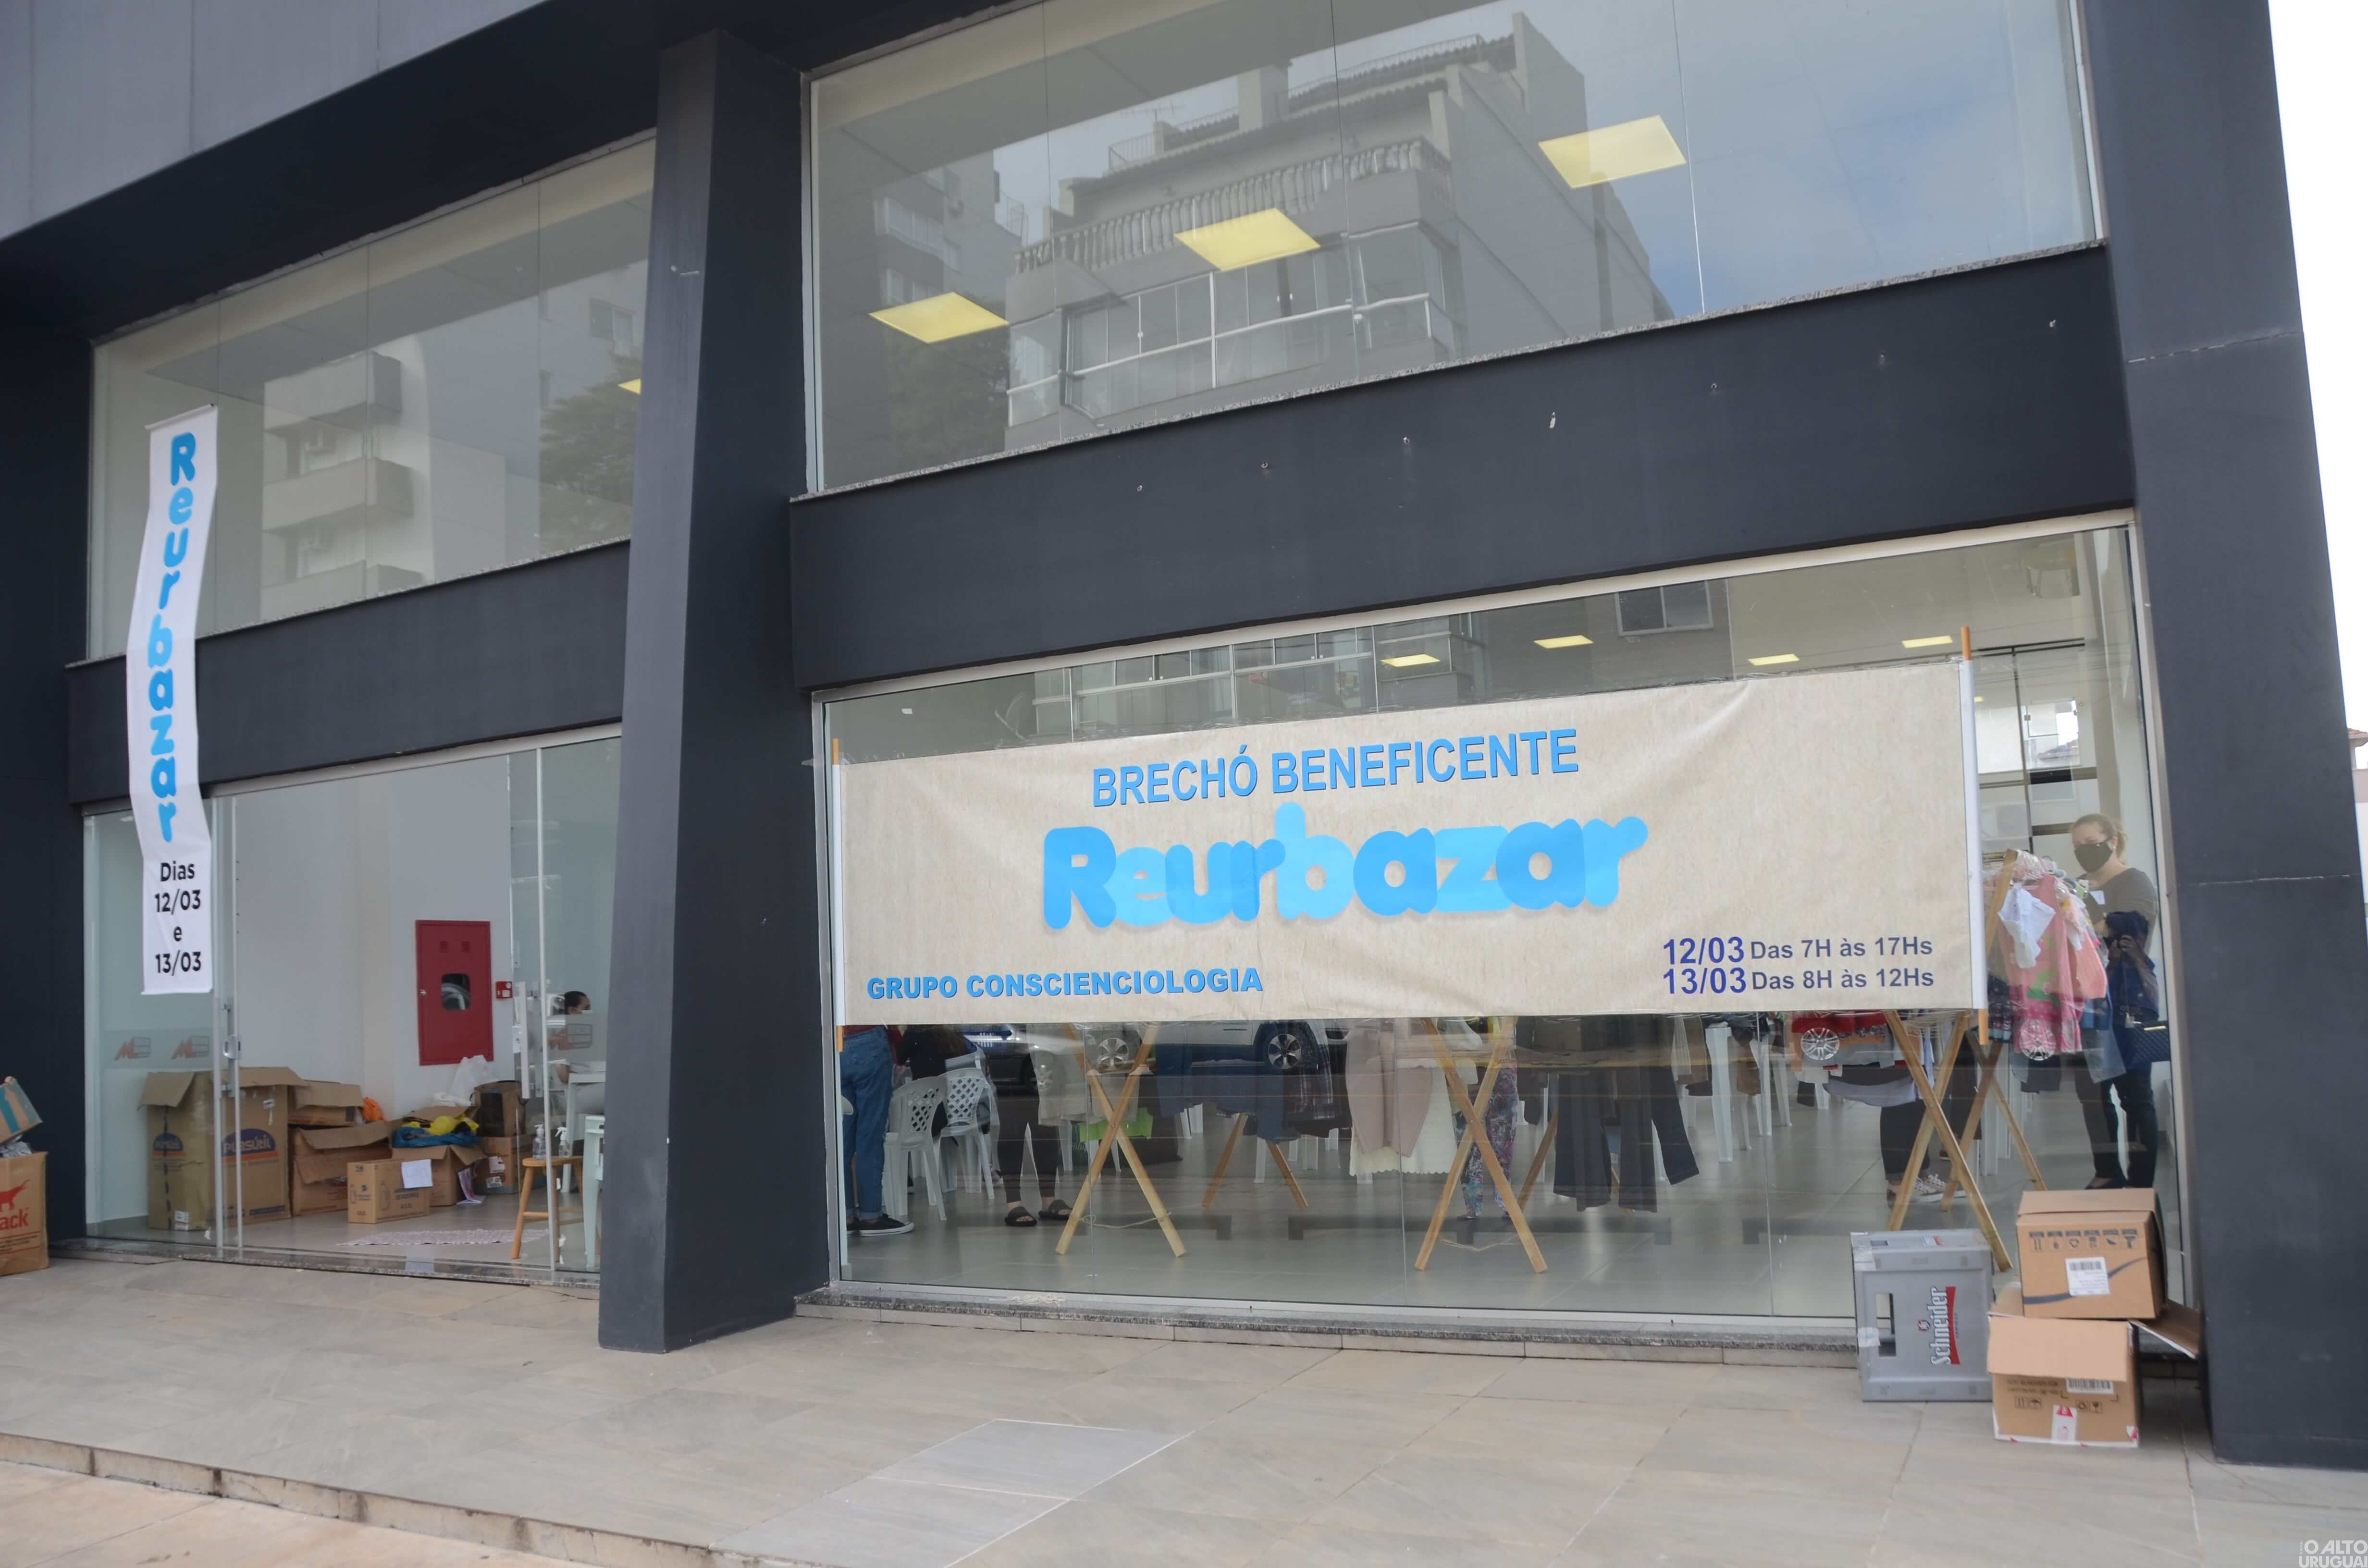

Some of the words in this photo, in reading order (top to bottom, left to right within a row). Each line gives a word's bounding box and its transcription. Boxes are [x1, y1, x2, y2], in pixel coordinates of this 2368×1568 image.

[147, 432, 197, 843] Reurbazar
[1092, 744, 1258, 807] BRECHÓ
[1271, 728, 1579, 793] BENEFICENTE
[160, 861, 195, 882] Dias
[1043, 801, 1649, 930] Reurbazar
[155, 888, 201, 915] 12/03
[173, 926, 182, 942] e
[155, 950, 201, 976] 13/03
[1663, 936, 1745, 965] 12/03
[1751, 941, 1793, 960] Das
[1801, 938, 1832, 958] 7H
[1840, 938, 1866, 957] às
[1875, 936, 1934, 956] 17Hs
[866, 975, 958, 1000] GRUPO
[965, 967, 1264, 998] CONSCIENCIOLOGIA
[1663, 967, 1747, 994] 13/03
[1752, 971, 1794, 990] Das
[1803, 970, 1833, 989] 8H
[1841, 969, 1867, 988] às
[1876, 968, 1935, 987] 12Hs
[1926, 1286, 1951, 1365] Schneider
